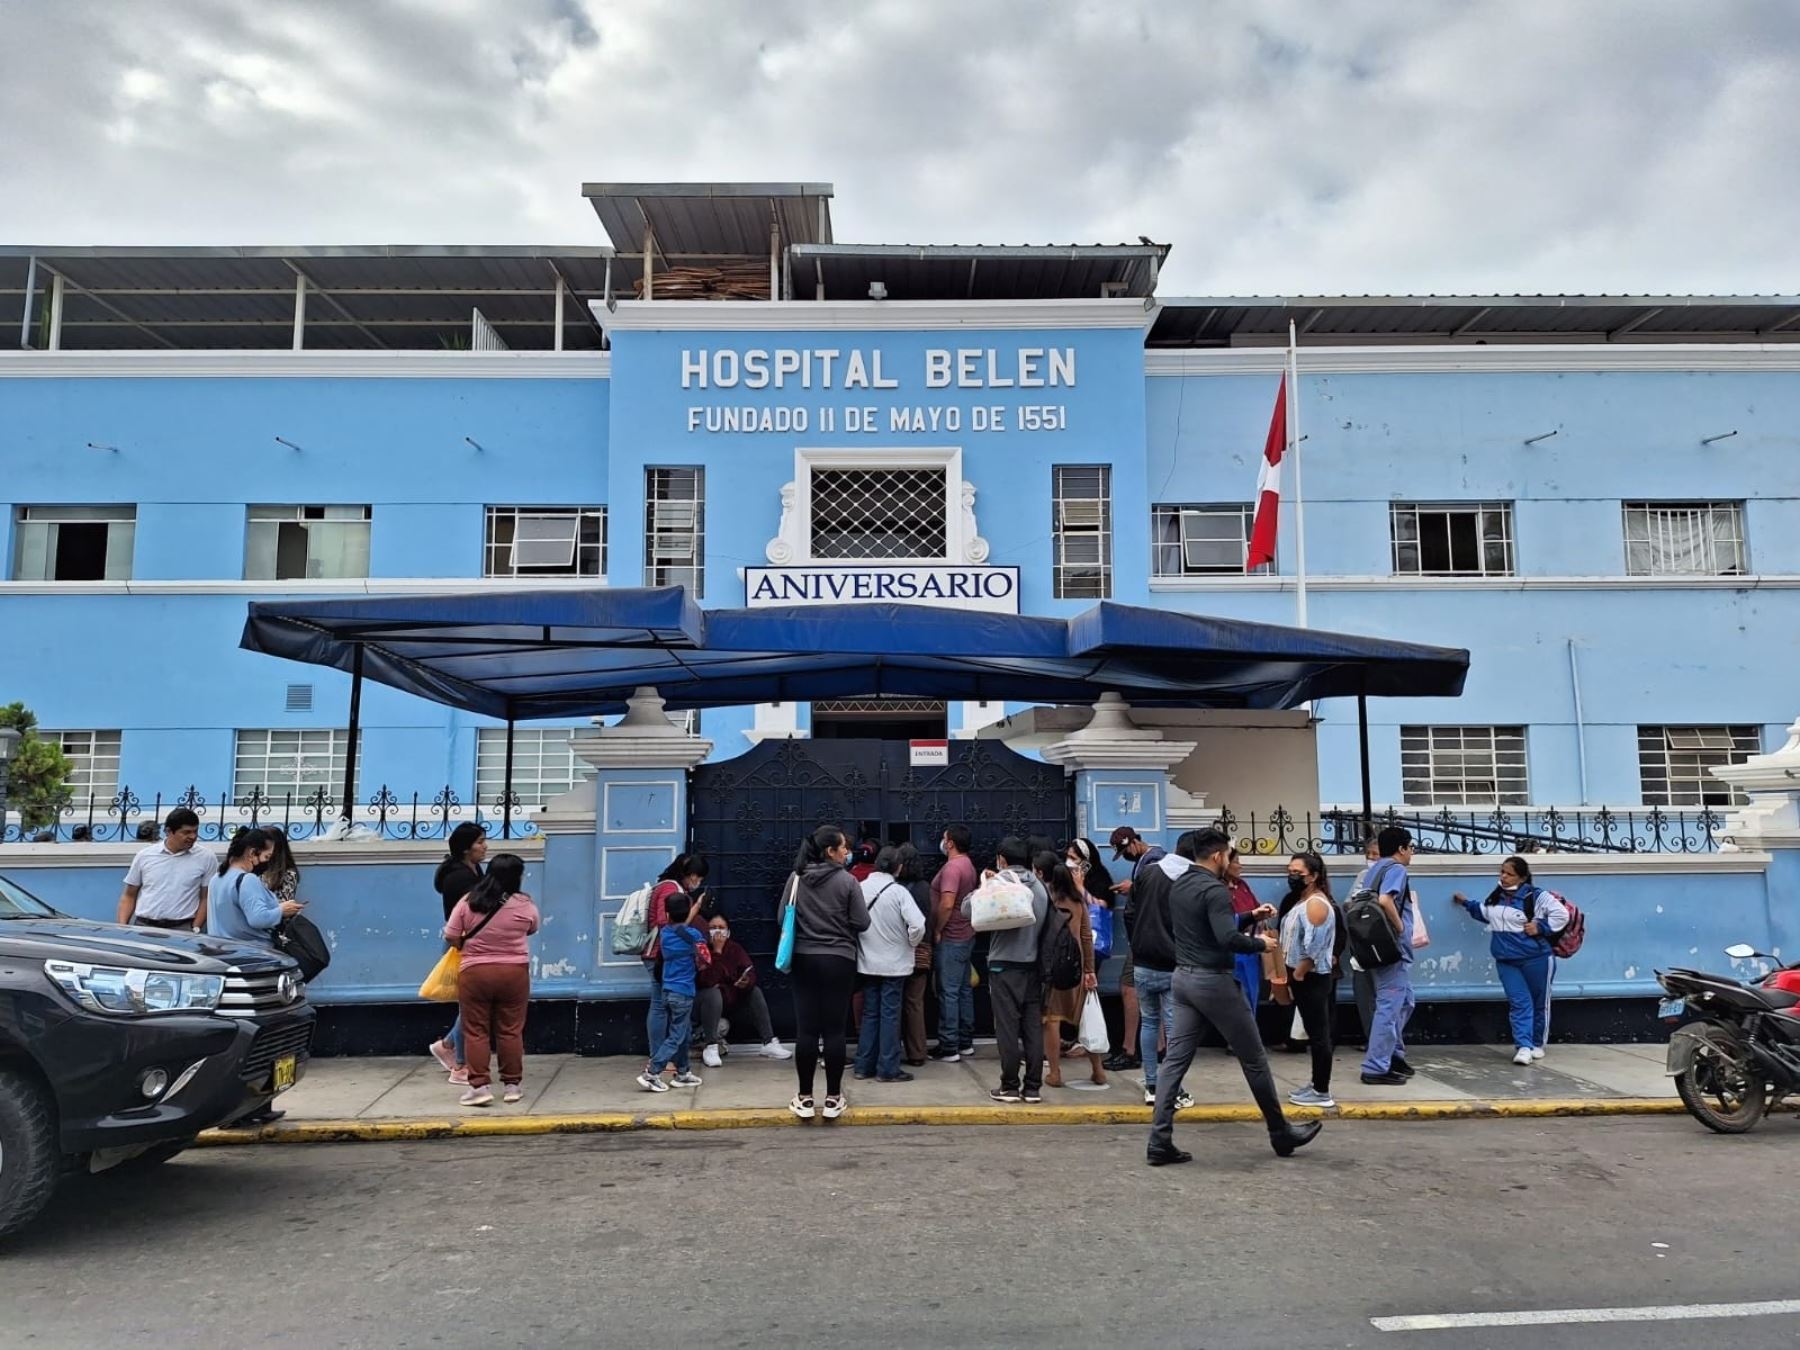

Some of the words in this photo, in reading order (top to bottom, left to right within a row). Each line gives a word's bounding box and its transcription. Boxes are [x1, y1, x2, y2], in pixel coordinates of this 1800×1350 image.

[681, 349, 898, 388] HOSPITAL
[925, 348, 1076, 387] BELEN
[687, 406, 808, 432] FUNDADO
[845, 406, 879, 432] DE
[889, 406, 961, 432] MAYO
[972, 406, 1006, 431] DE
[1017, 405, 1067, 431] 1551
[752, 573, 1013, 599] ANIVERSARIO
